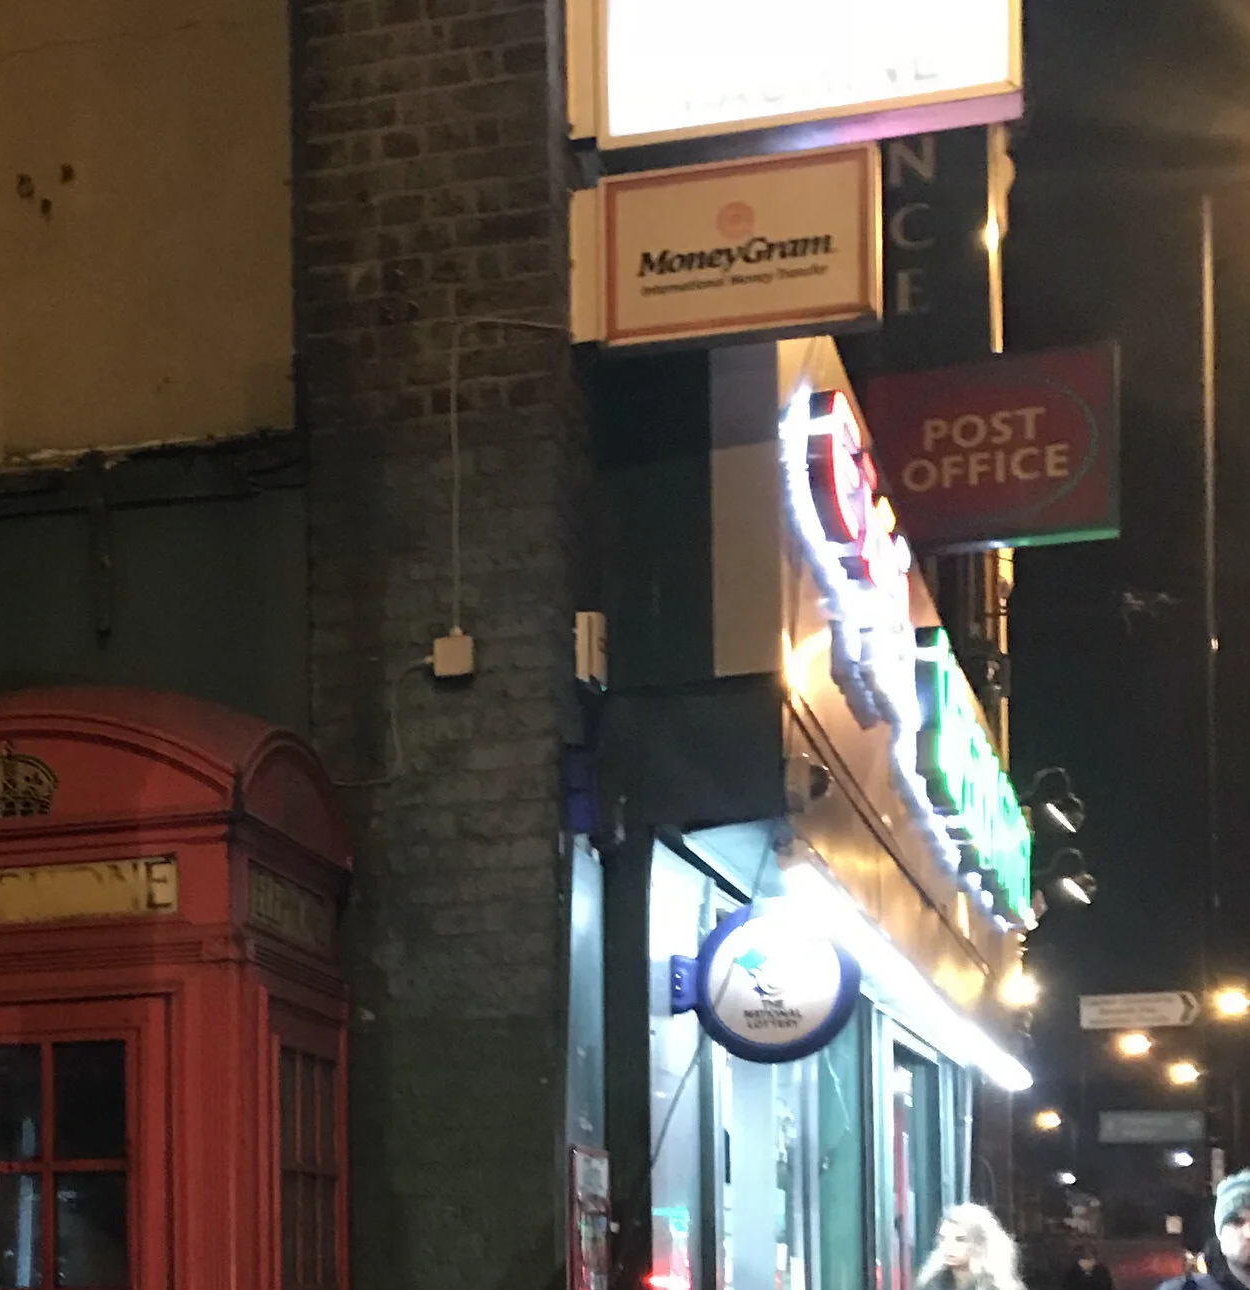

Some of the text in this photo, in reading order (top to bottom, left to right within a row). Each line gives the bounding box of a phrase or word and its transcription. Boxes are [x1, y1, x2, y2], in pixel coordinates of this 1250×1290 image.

[637, 233, 833, 278] MoneyGram
[922, 406, 1047, 451] POST
[901, 443, 1070, 493] OFFICE
[743, 1008, 803, 1020] NATIONAL
[746, 1018, 798, 1029] LOTTERY
